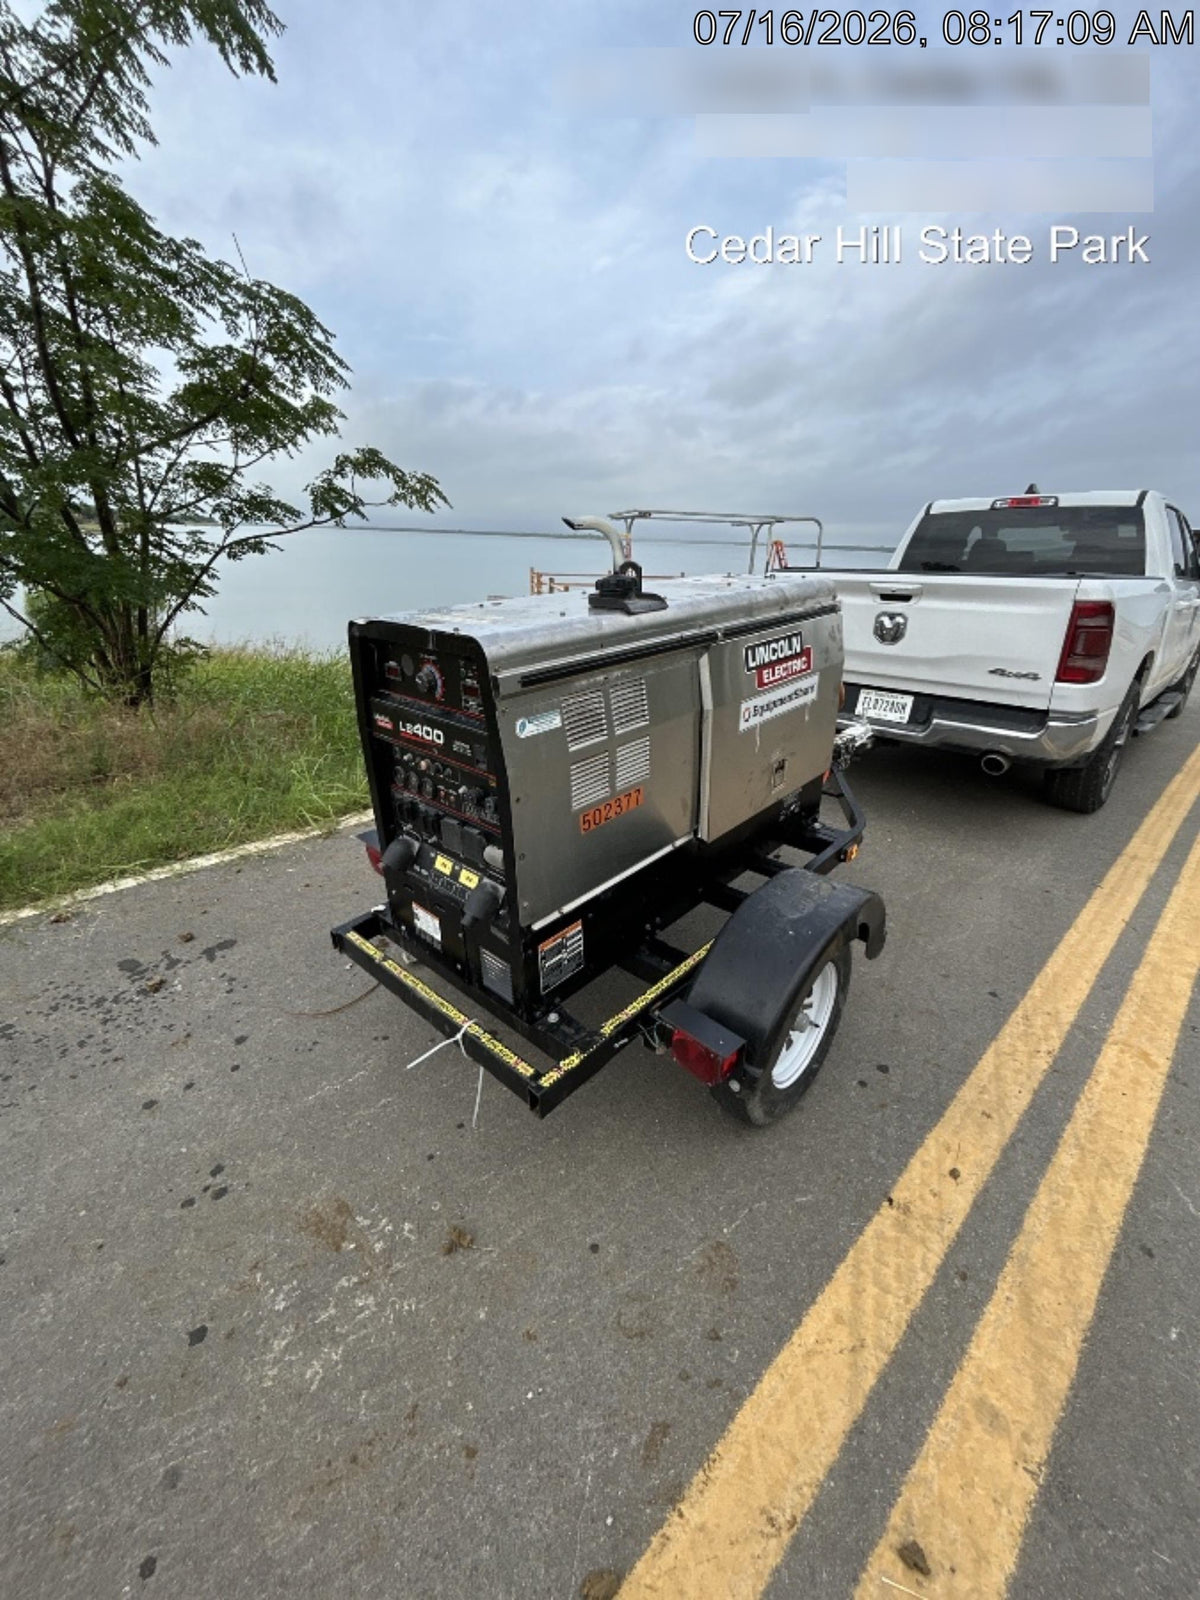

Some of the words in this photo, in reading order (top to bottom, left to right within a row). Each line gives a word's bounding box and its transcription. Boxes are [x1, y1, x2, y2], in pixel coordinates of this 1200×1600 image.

[747, 634, 802, 668] LINCOLN
[762, 656, 809, 684] ELECTRIC
[581, 787, 642, 833] 502377
